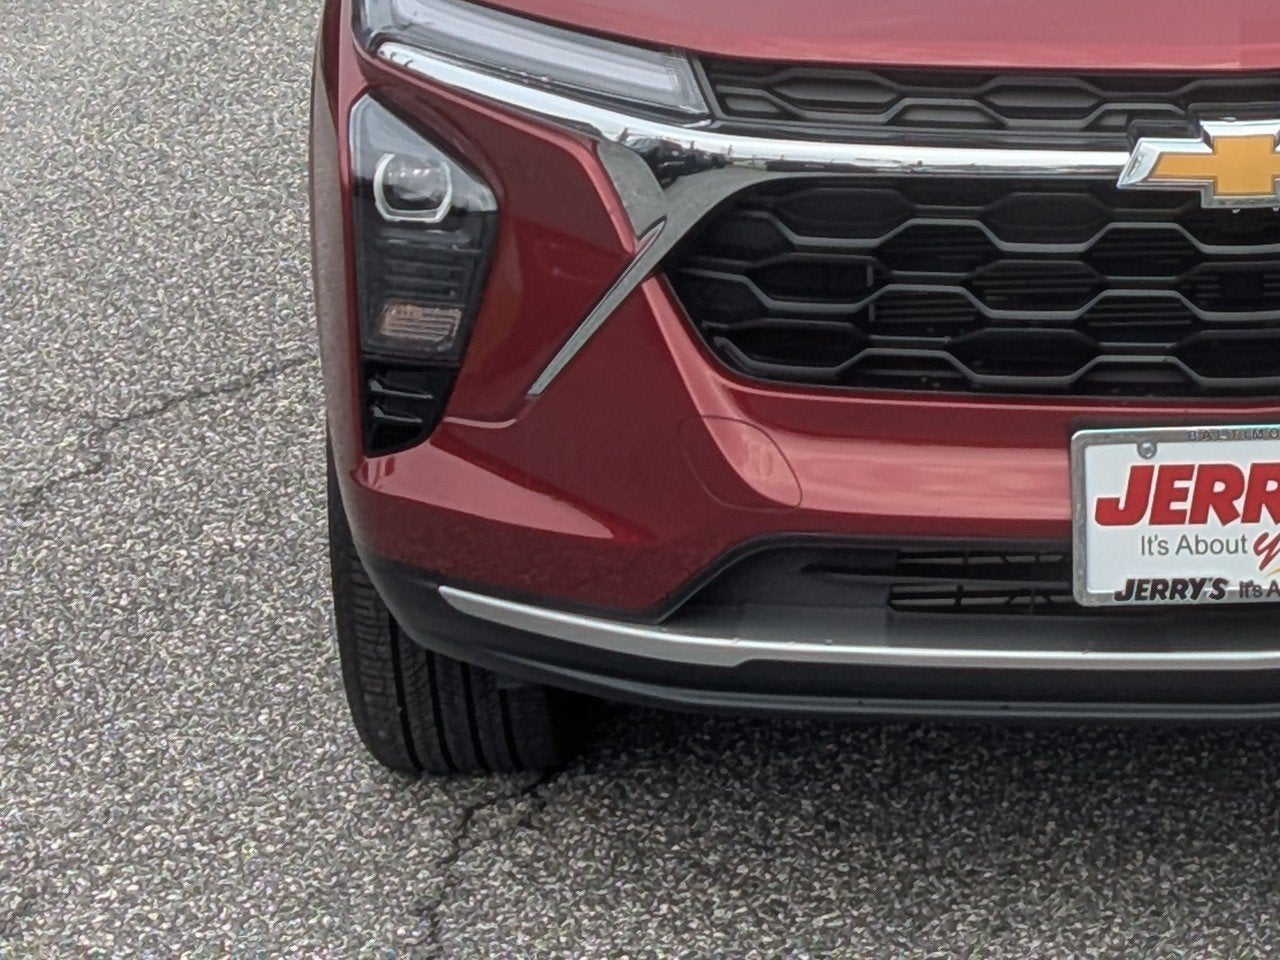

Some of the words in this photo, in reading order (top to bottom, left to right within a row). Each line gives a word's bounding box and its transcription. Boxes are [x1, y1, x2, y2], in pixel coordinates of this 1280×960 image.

[1141, 534, 1169, 556] It's
[1175, 534, 1248, 556] About
[1114, 577, 1230, 602] JERRY'S
[1238, 581, 1265, 599] It's
